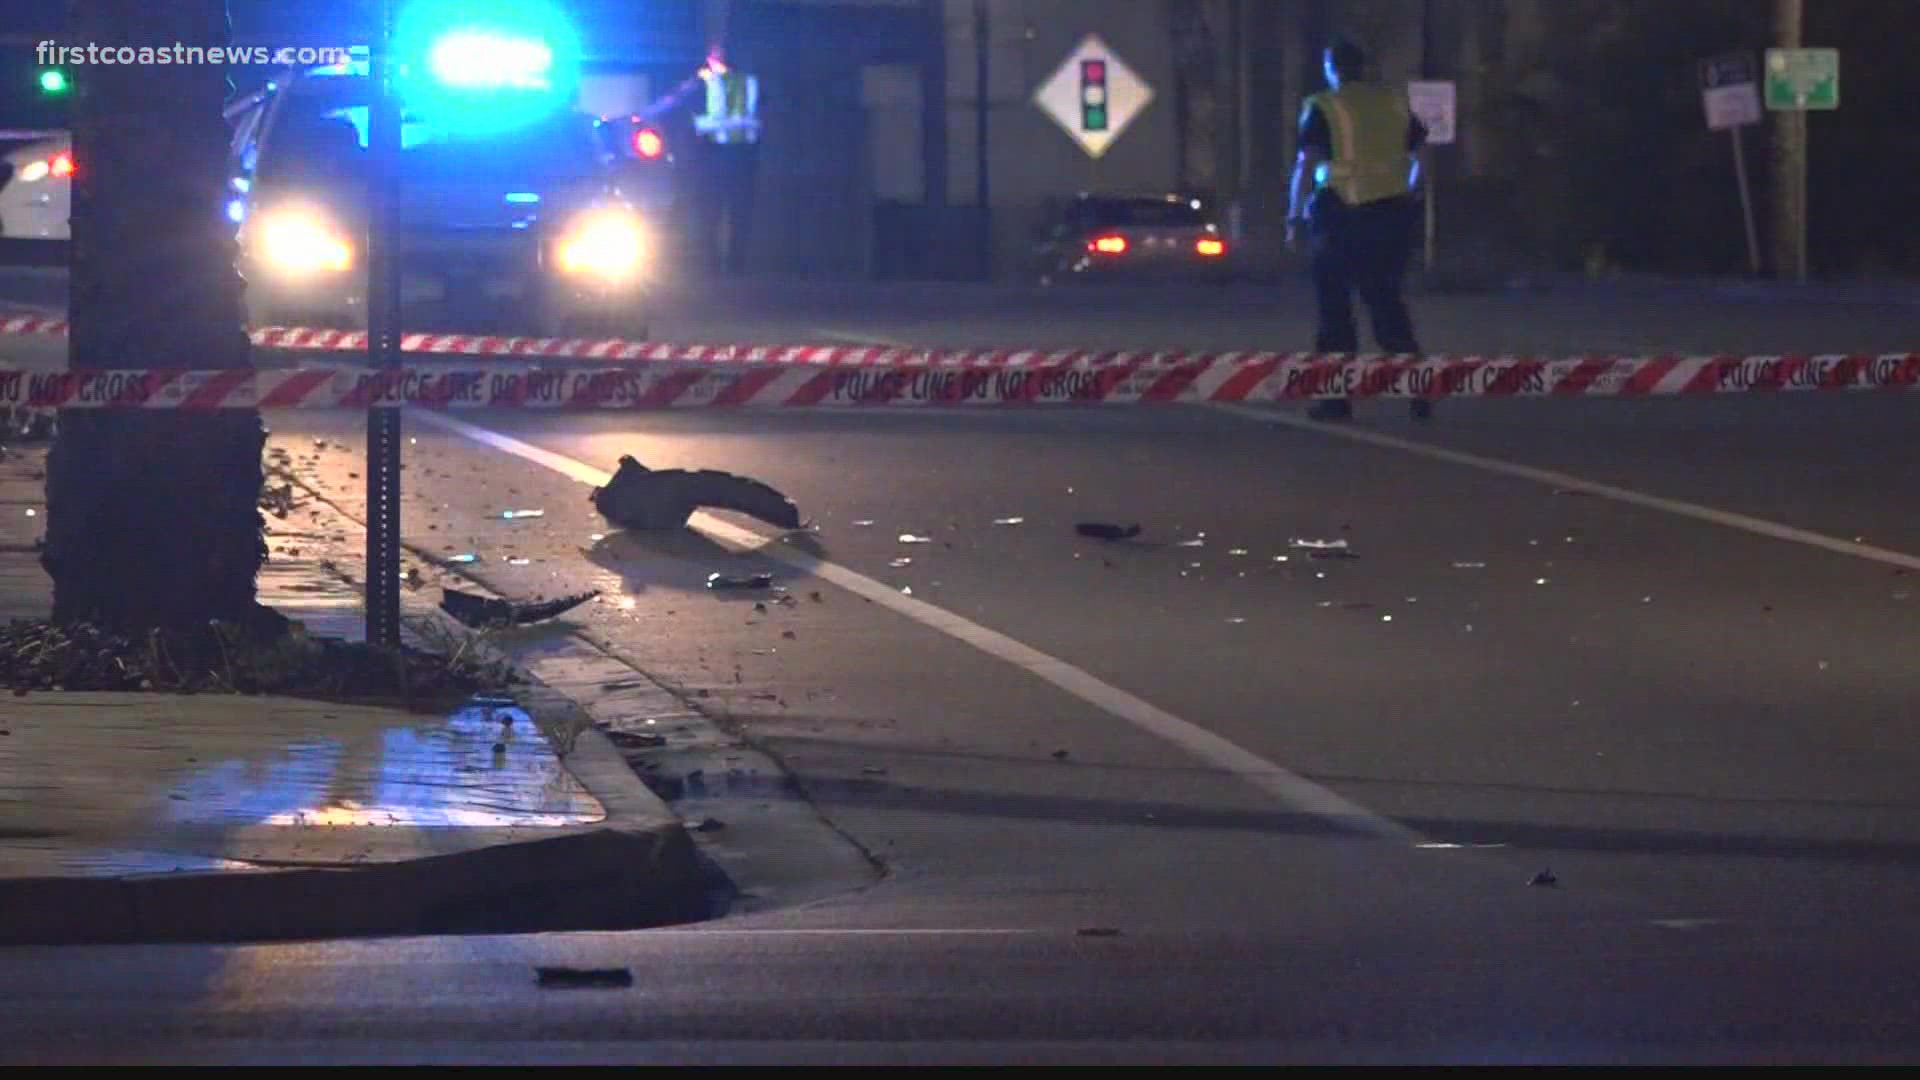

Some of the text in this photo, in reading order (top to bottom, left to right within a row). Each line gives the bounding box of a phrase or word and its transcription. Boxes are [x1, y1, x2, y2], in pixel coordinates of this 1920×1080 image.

[79, 372, 150, 402] CROSS
[354, 373, 433, 402] POLICE
[573, 372, 640, 402] CROSS
[833, 371, 906, 401] POLICE
[911, 371, 956, 401] LINE
[960, 371, 989, 401] DO
[994, 371, 1034, 401] NOT
[1039, 370, 1107, 401] CROSS
[1285, 367, 1357, 395] POLICE
[1407, 366, 1434, 394] DO
[1481, 365, 1544, 393] CROSS
[1717, 361, 1786, 387] POLICE
[1789, 361, 1828, 387] LINE
[1864, 359, 1904, 386] NOT
